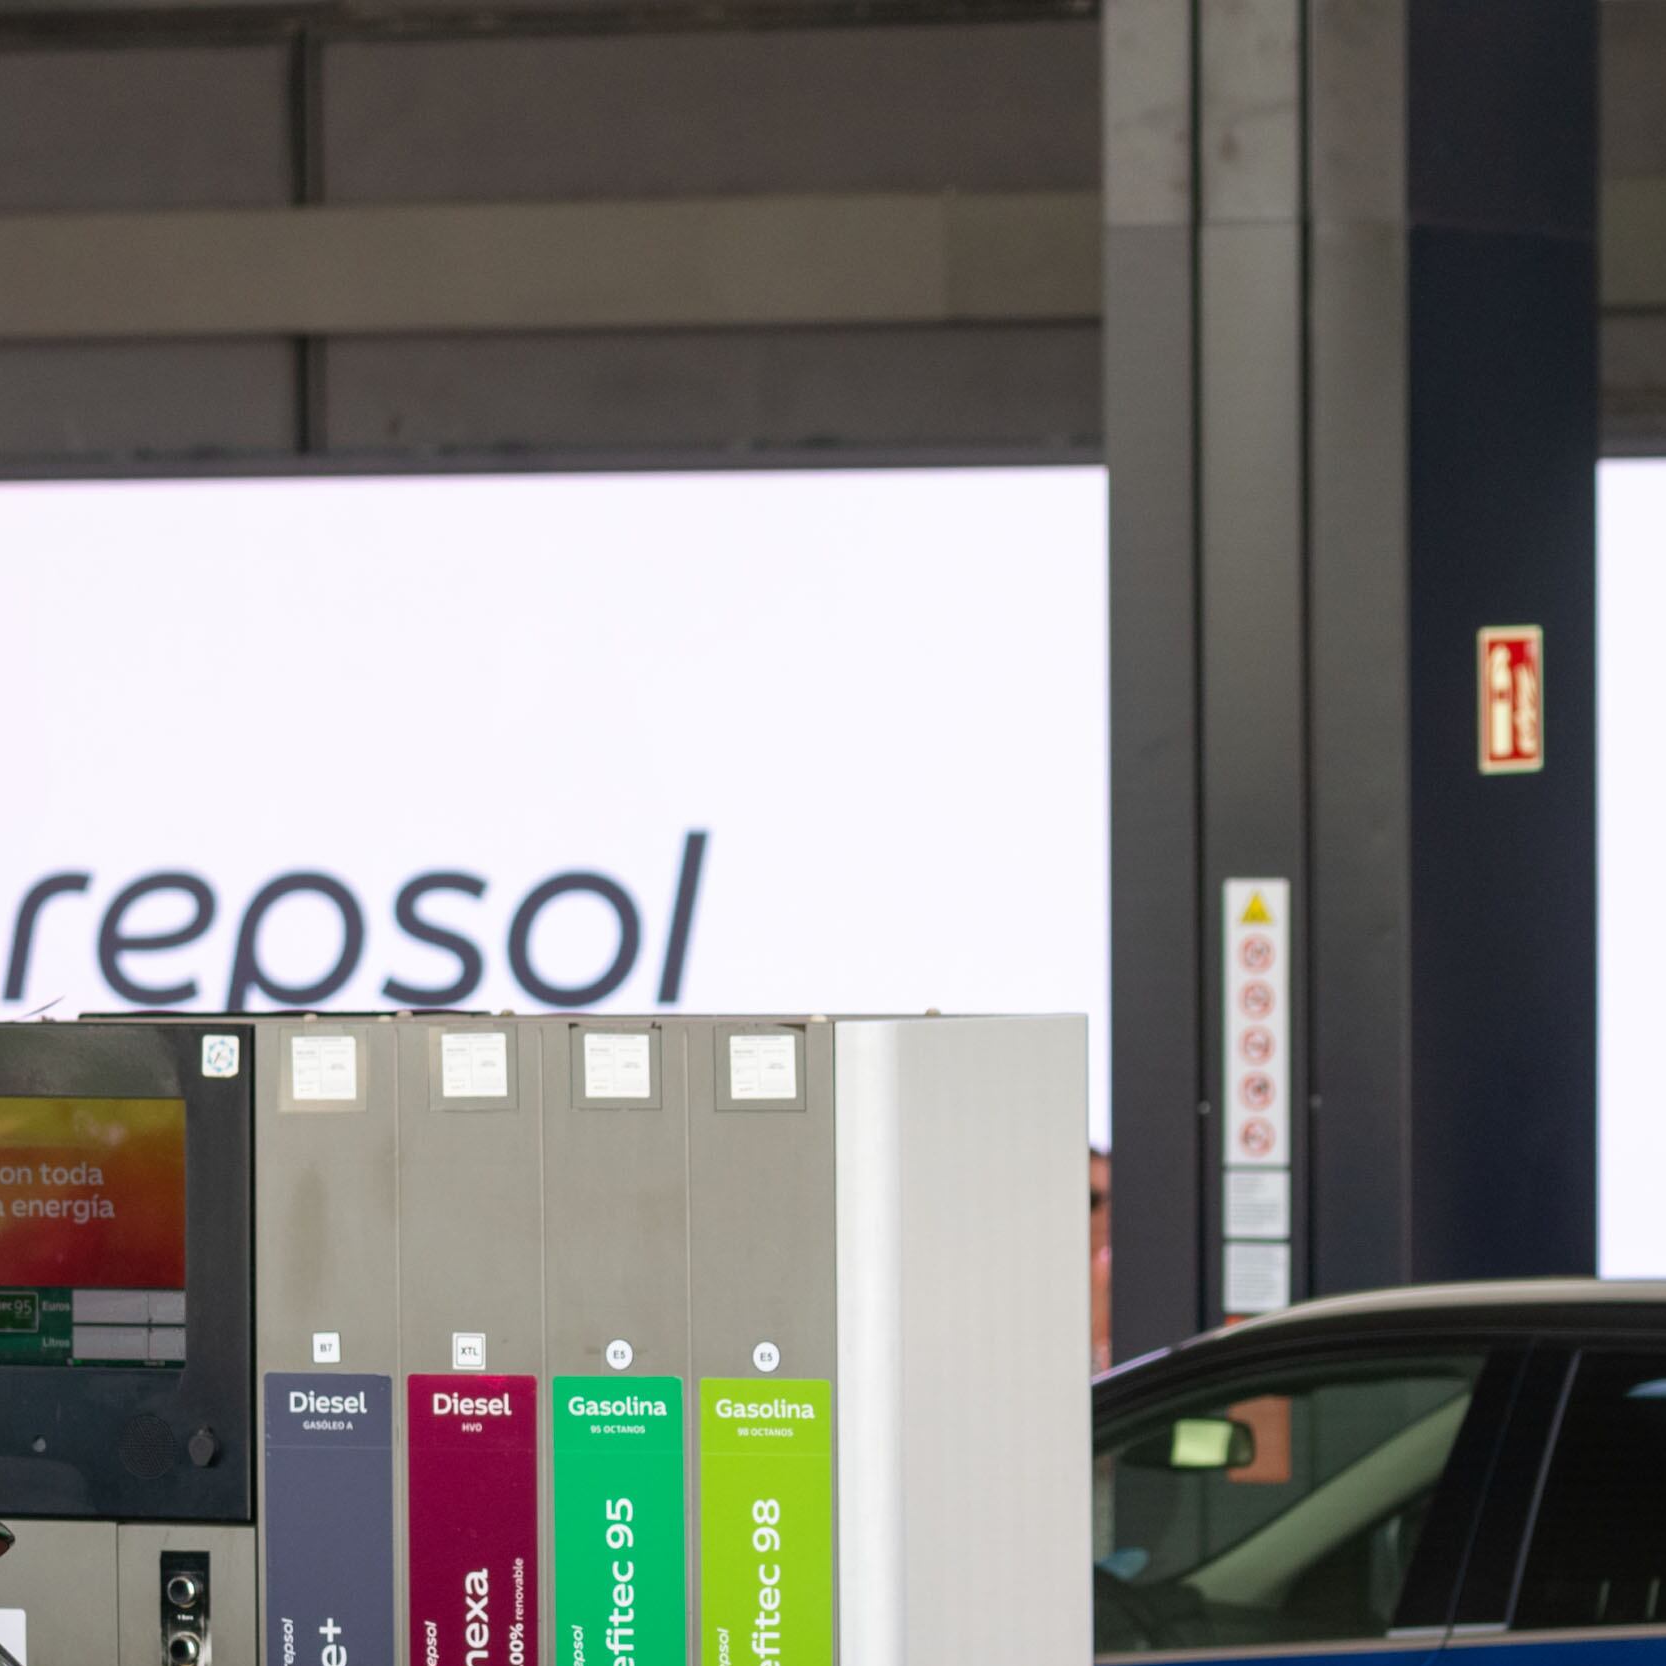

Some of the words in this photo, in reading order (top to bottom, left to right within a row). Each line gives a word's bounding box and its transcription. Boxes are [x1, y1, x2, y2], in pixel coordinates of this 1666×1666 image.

[1, 829, 710, 1012] repsol
[40, 1162, 104, 1185] toda
[12, 1194, 115, 1224] energía
[14, 1301, 33, 1316] 95
[42, 1301, 71, 1312] Euros
[42, 1336, 71, 1348] Litros
[461, 1347, 479, 1357] XTL
[613, 1350, 626, 1360] E5
[760, 1352, 773, 1362] E5
[289, 1391, 367, 1414] Diesel
[433, 1392, 512, 1416] Diesel
[568, 1396, 667, 1417] Gasolina
[715, 1398, 815, 1419] Gasolina
[346, 1421, 353, 1431] A
[461, 1423, 482, 1432] HVO
[590, 1425, 602, 1434] 95
[604, 1425, 646, 1435] OCTANOS
[751, 1428, 794, 1437] OCTANOS
[606, 1498, 634, 1549] 95
[752, 1498, 781, 1552] 98
[512, 1557, 524, 1621] renovable
